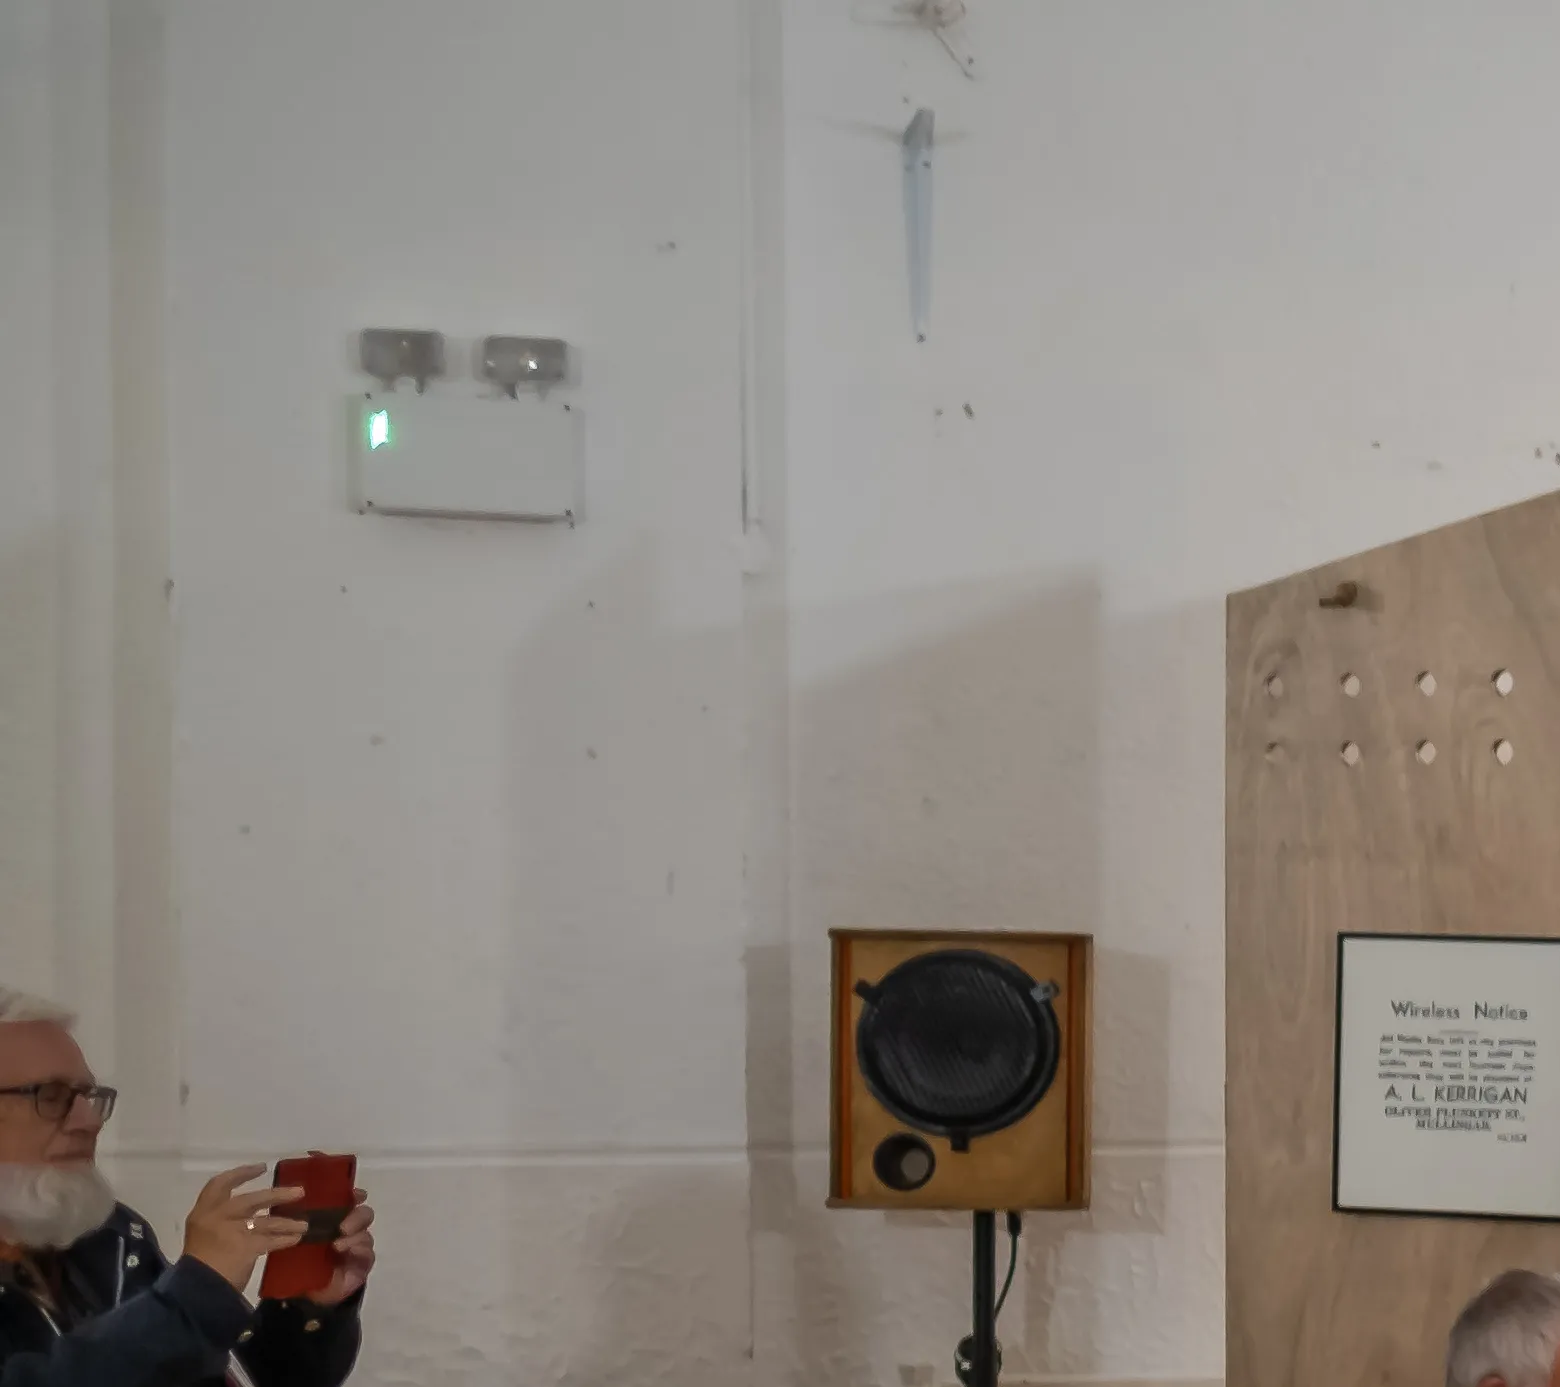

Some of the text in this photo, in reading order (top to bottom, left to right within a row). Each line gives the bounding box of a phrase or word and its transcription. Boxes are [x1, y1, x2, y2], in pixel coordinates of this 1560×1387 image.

[1390, 999, 1529, 1021] Wireless Notice
[1434, 1085, 1528, 1104] KERRIGAN
